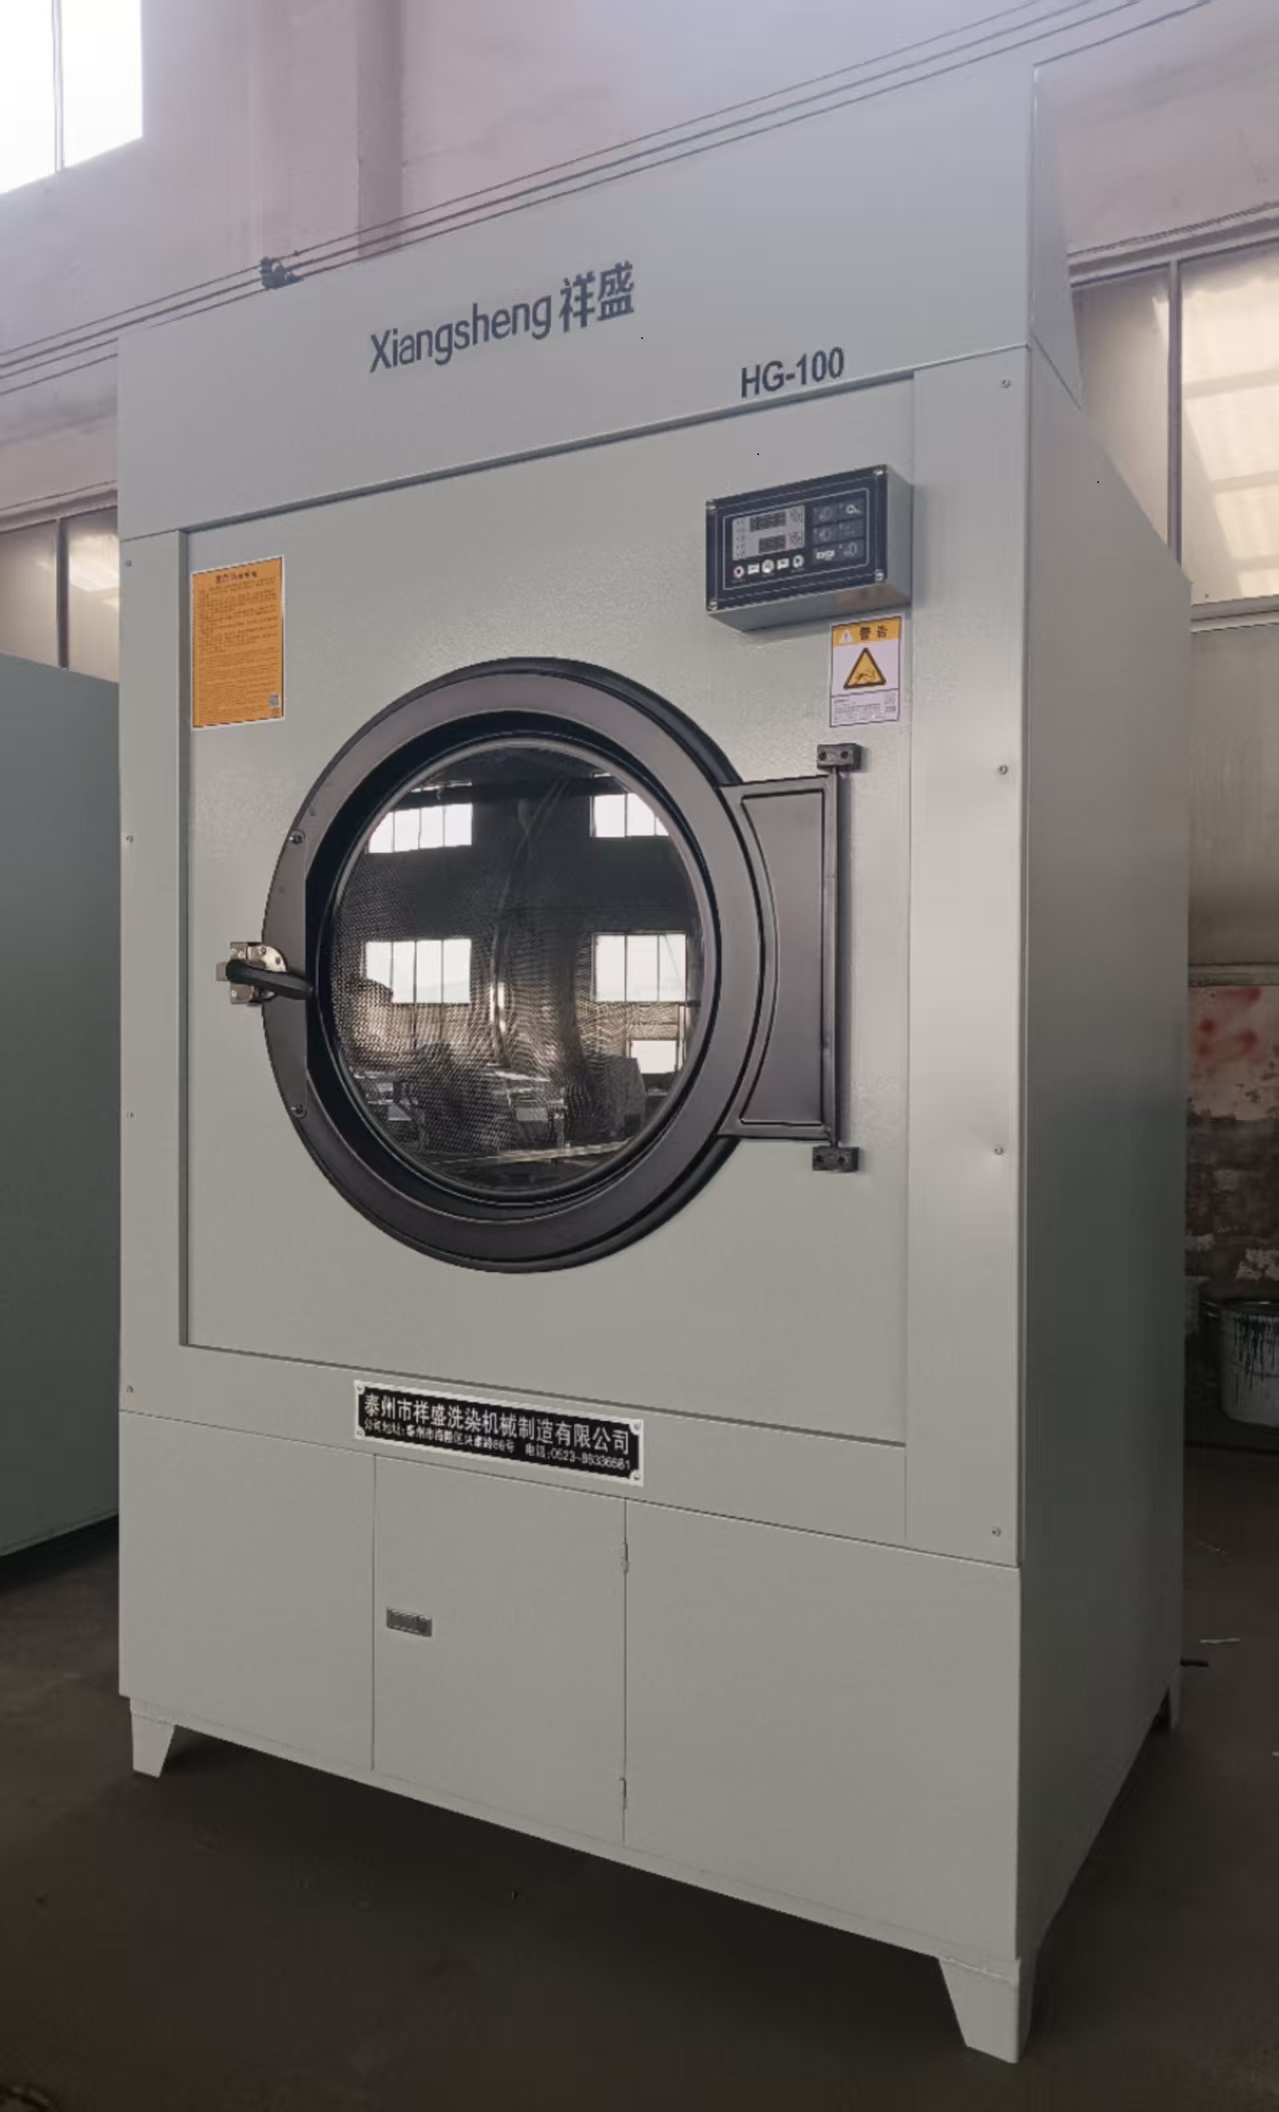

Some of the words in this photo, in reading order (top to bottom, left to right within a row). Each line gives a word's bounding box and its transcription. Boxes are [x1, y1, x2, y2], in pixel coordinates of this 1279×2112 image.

[369, 295, 552, 373] Xiangsheng
[559, 260, 635, 333] 祥盛
[740, 347, 845, 398] HG-100
[364, 1393, 629, 1456] 泰州市祥盛洗染机械制造有限公司
